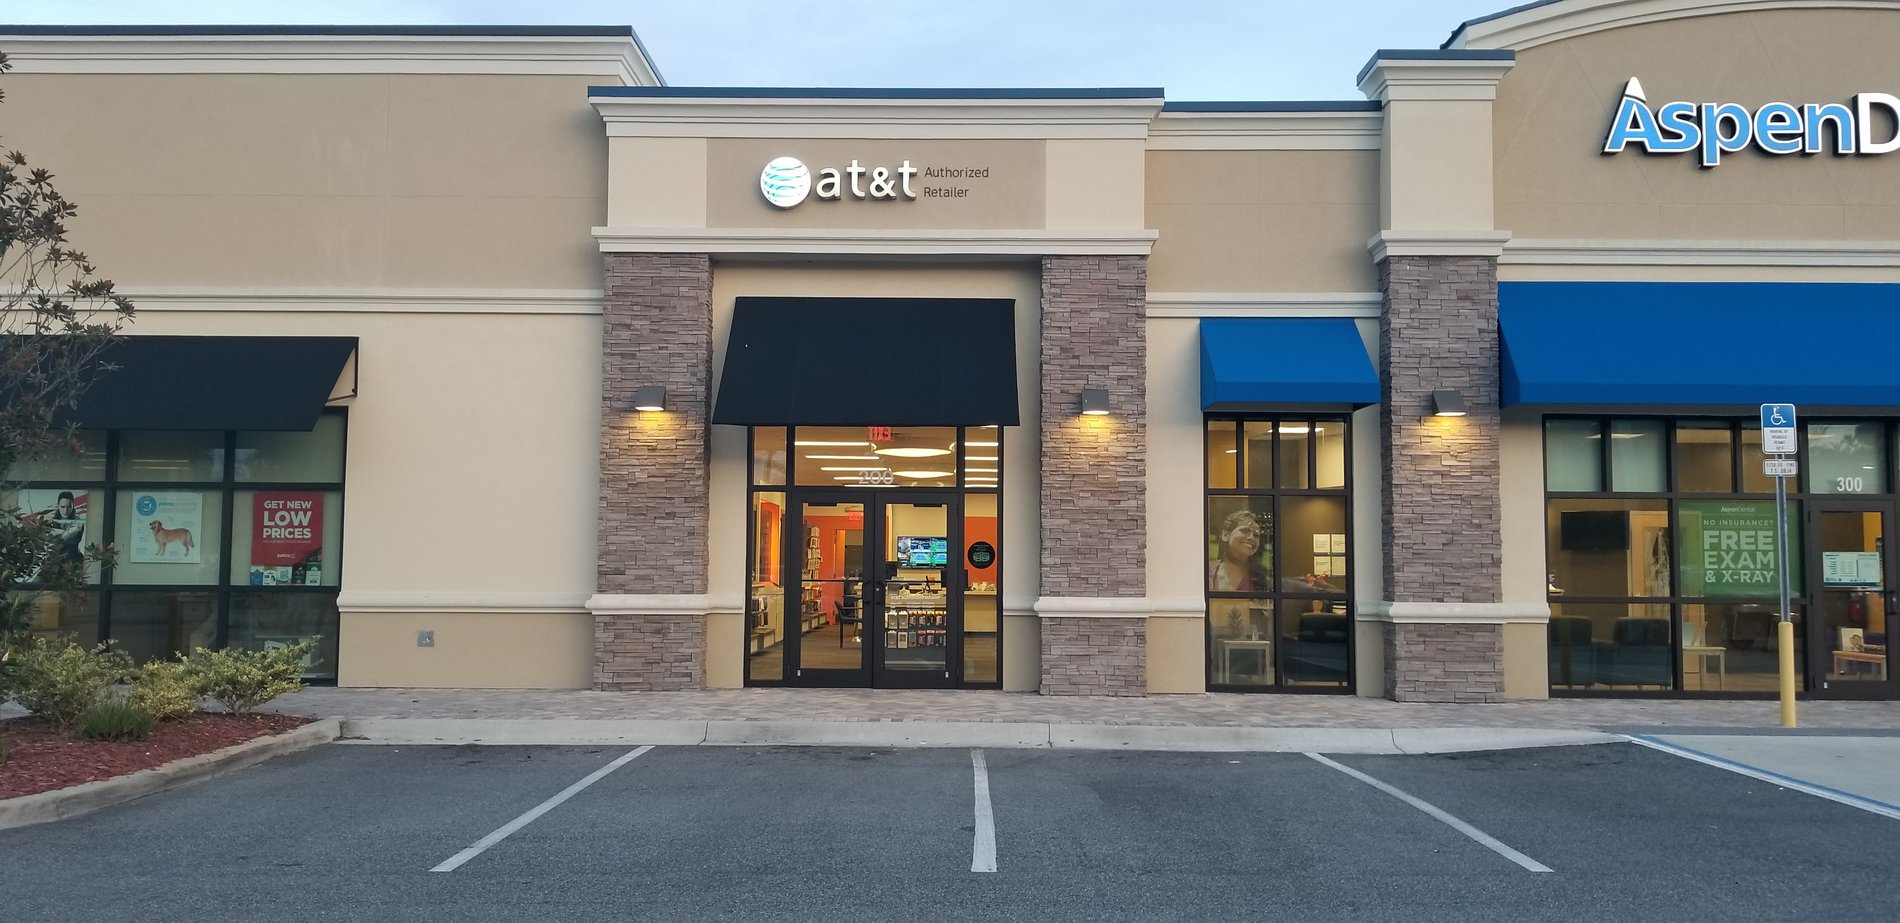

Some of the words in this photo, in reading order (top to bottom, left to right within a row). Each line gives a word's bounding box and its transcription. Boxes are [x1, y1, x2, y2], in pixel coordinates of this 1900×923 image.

[816, 159, 918, 200] at&t
[924, 166, 989, 179] Authorized
[923, 186, 969, 198] Retailer
[859, 470, 894, 485] 200
[1836, 477, 1863, 492] 300
[264, 500, 284, 509] GET
[287, 501, 312, 509] NEW
[263, 511, 312, 526] LOW
[263, 528, 312, 539] PRICES
[1703, 530, 1774, 550] FREE
[1704, 551, 1775, 569] EXAM
[1705, 570, 1716, 583] &
[1722, 570, 1775, 583] X-RAY
